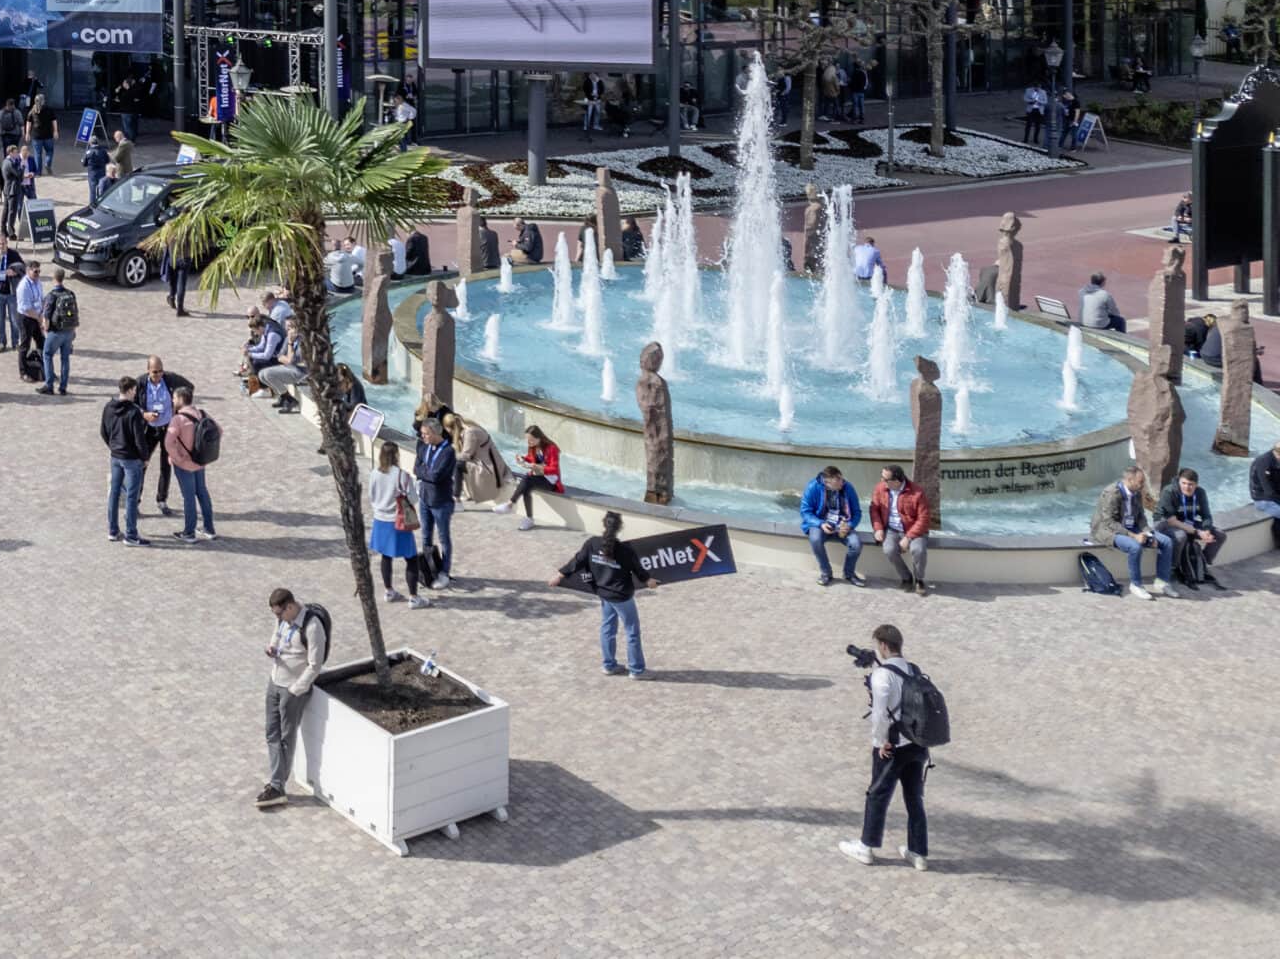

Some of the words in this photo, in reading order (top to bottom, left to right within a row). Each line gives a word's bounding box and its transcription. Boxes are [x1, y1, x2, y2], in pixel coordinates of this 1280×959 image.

[36, 218, 48, 226] VIP
[941, 468, 991, 480] runnen
[995, 464, 1017, 478] der
[1021, 457, 1086, 477] Begegnung
[640, 535, 722, 572] erNetX
